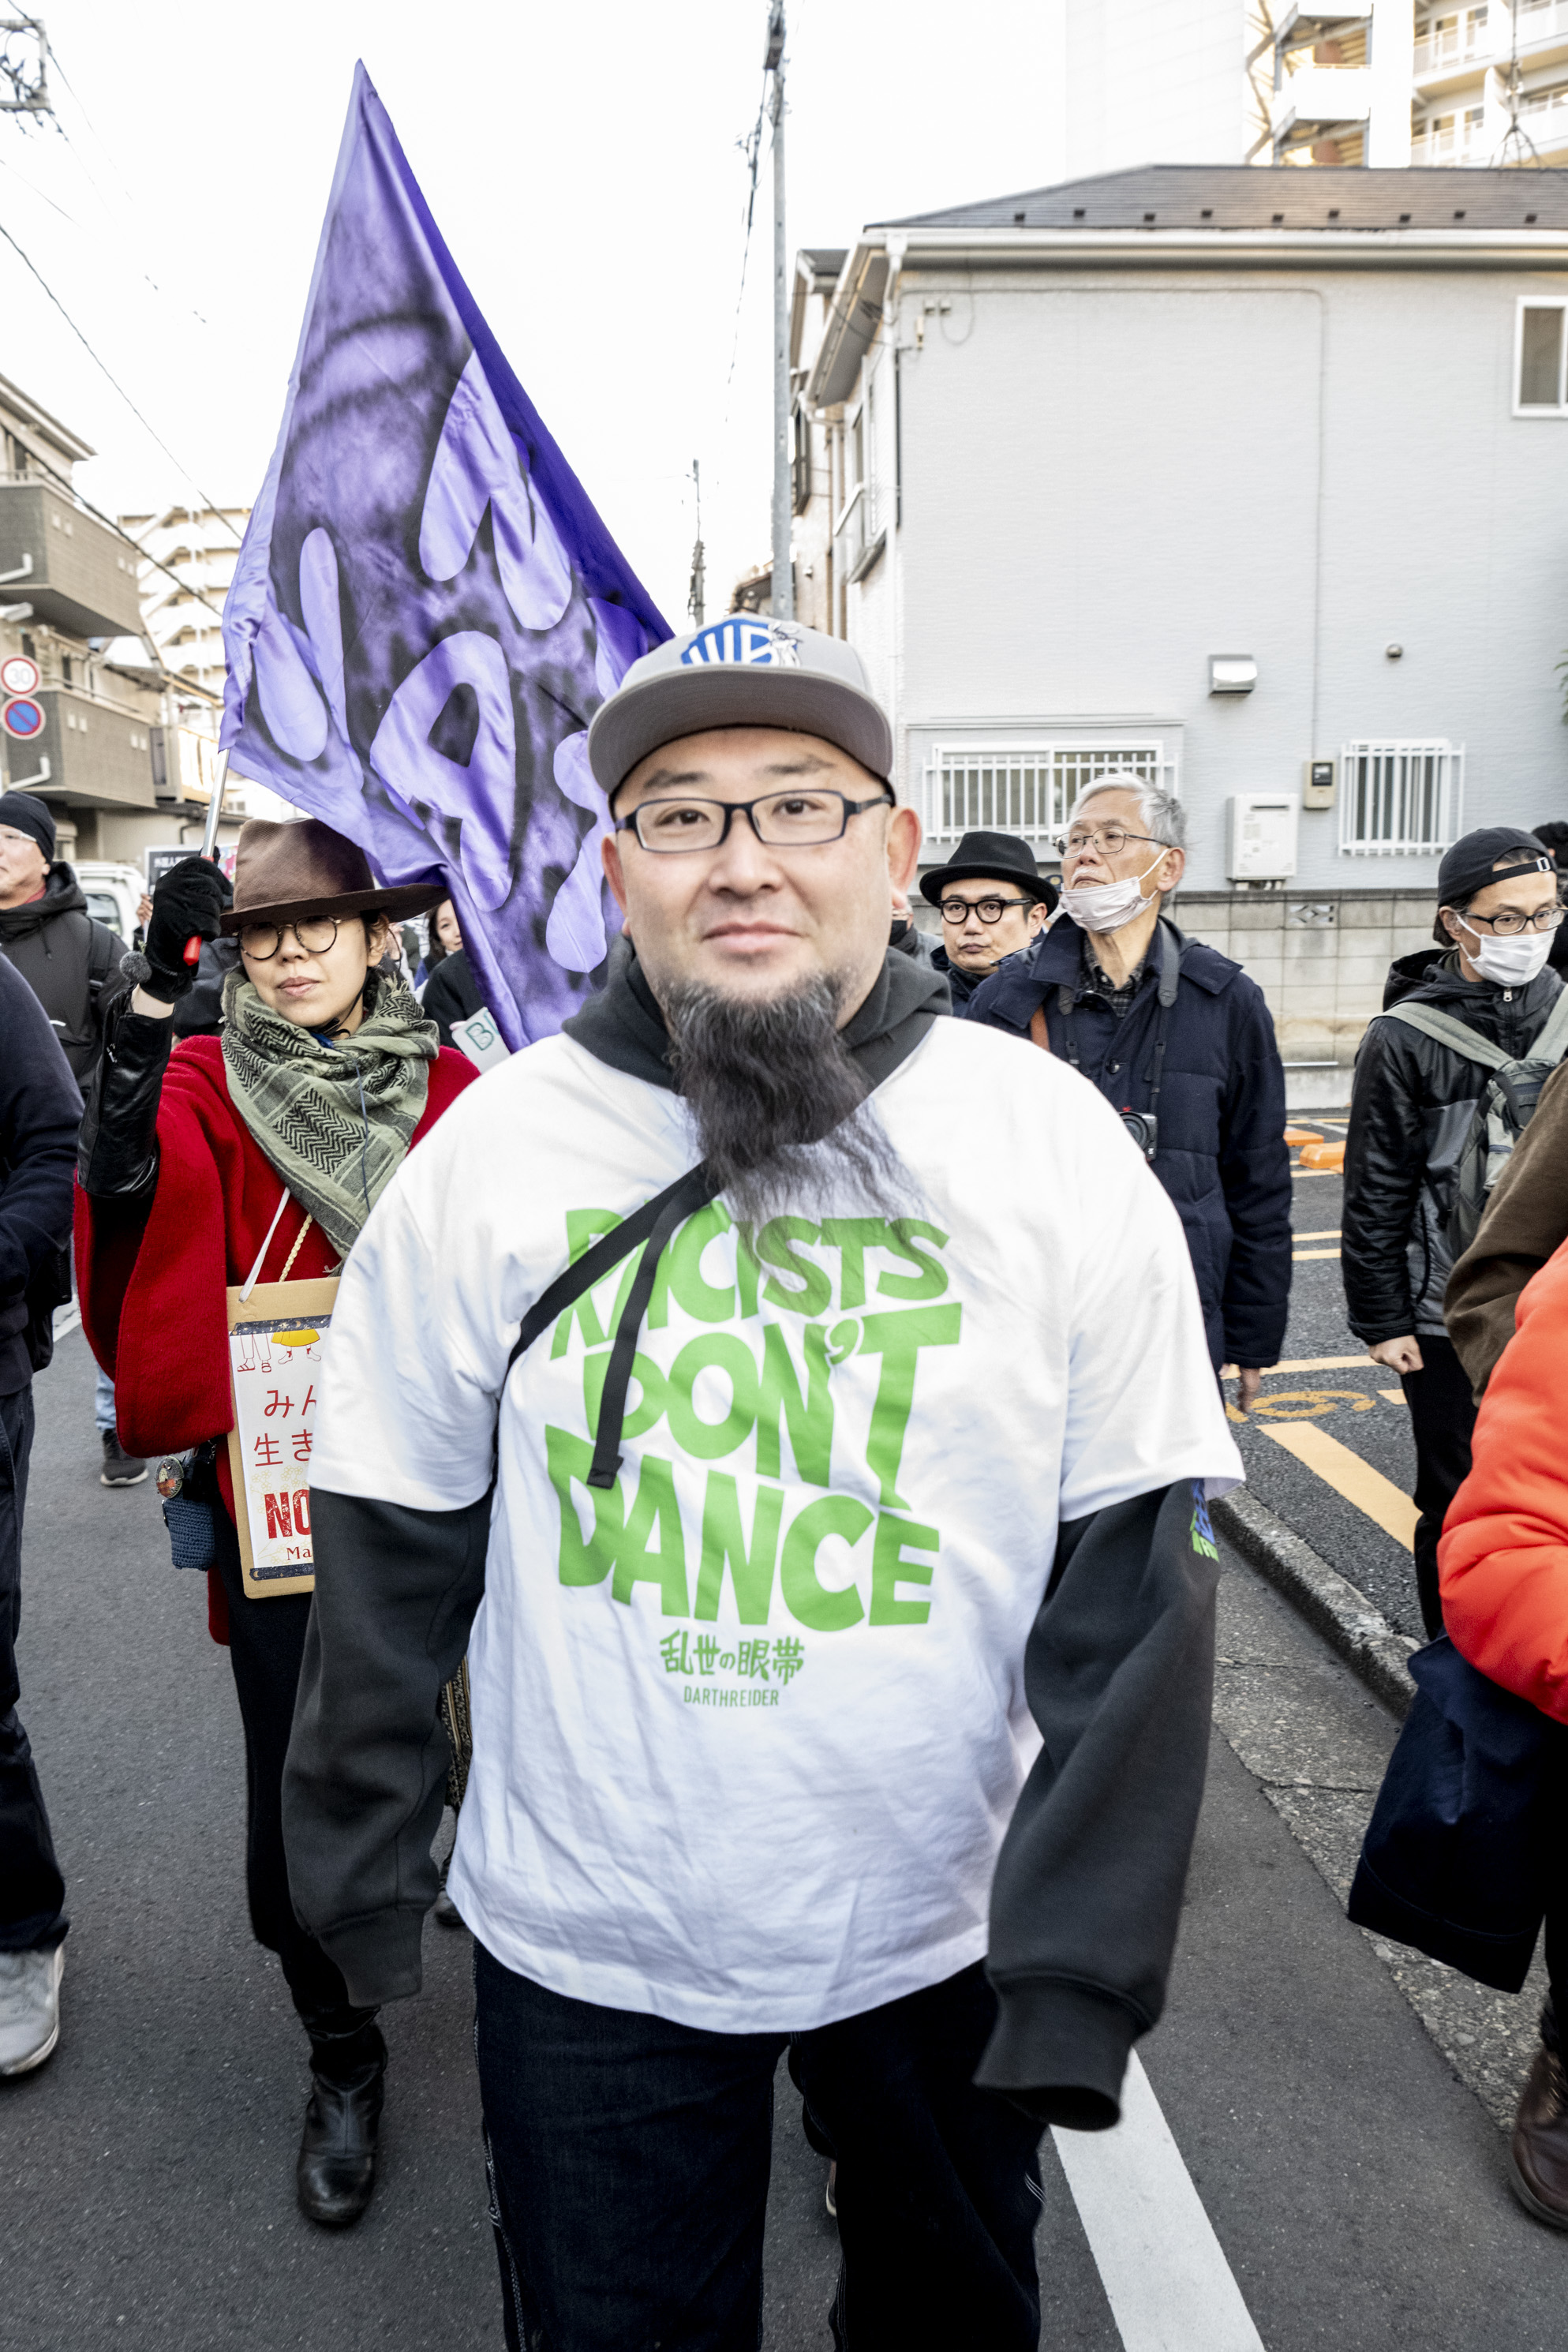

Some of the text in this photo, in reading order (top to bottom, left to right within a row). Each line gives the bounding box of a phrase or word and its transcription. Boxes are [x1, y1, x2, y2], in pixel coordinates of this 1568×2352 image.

[9, 668, 32, 685] 30
[544, 1424, 940, 1631] DANCE
[659, 1628, 806, 1687] 乱世の眼帯
[683, 1684, 780, 1708] DARTHREIDER
